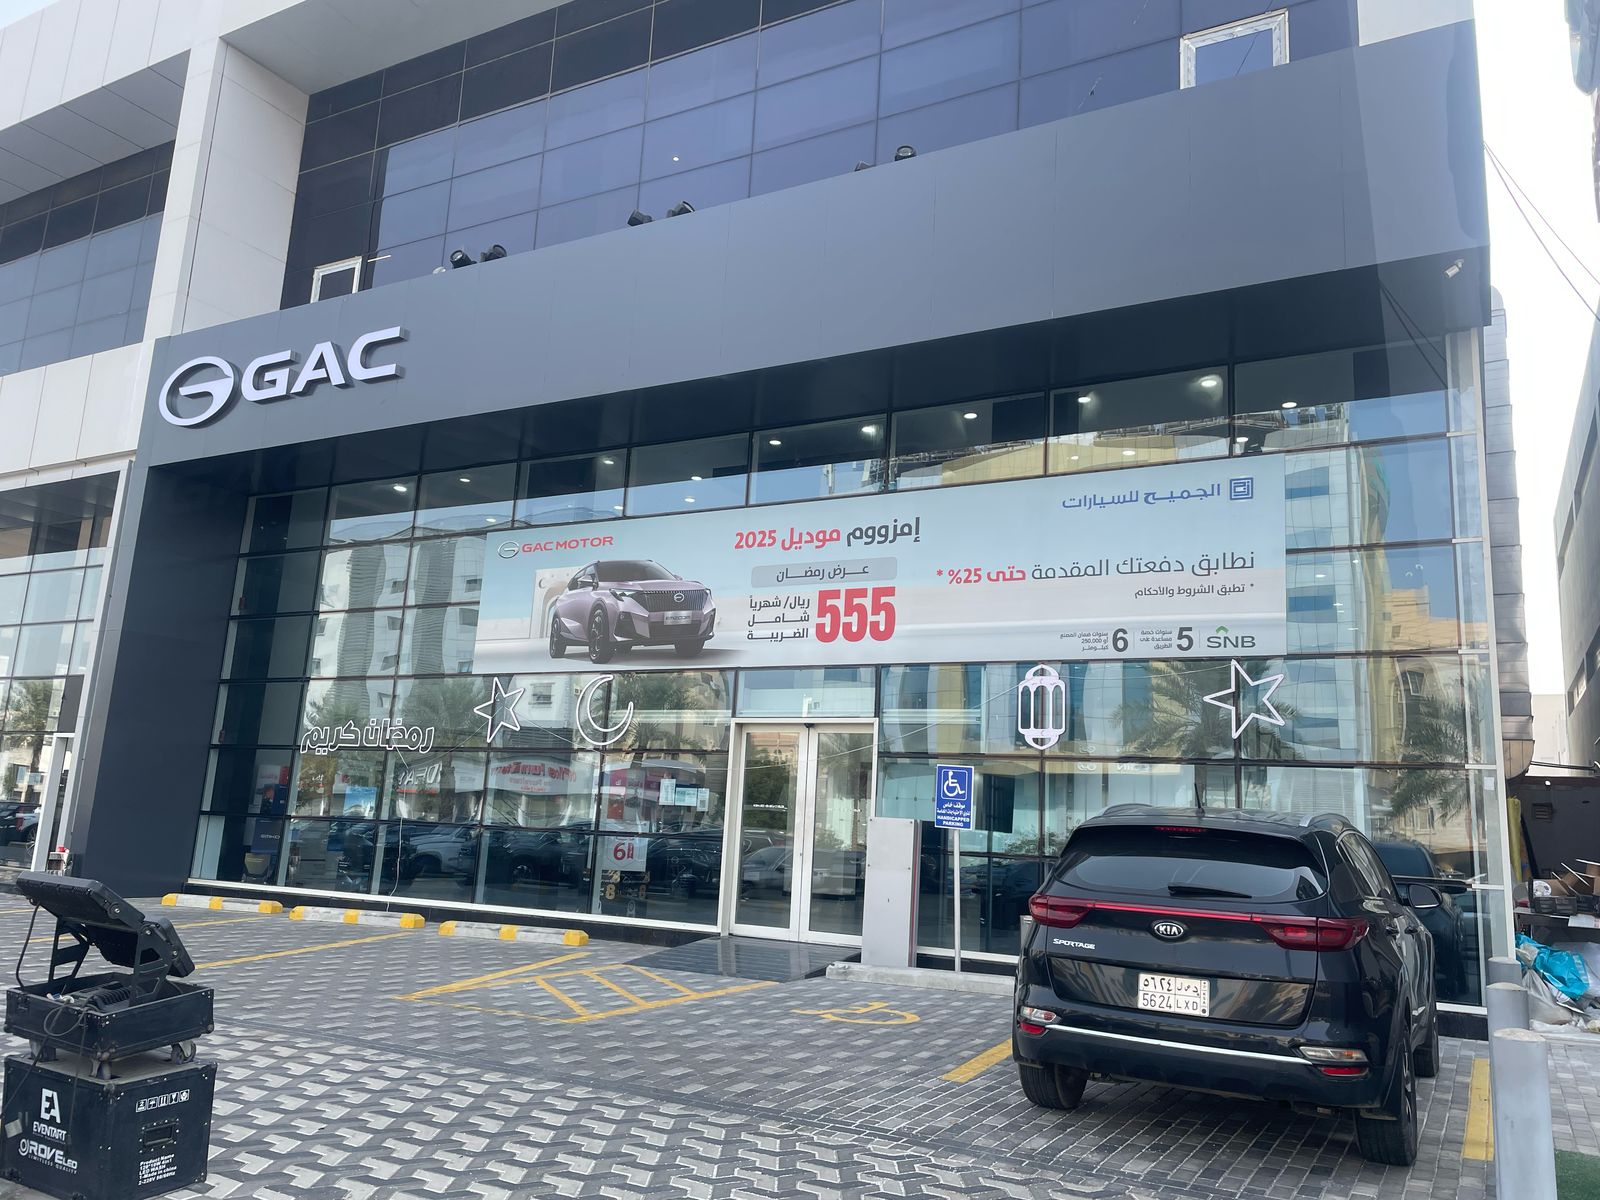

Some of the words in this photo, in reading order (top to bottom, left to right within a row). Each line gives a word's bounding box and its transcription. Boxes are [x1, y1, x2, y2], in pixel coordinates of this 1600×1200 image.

[241, 326, 406, 404] GAC
[1062, 489, 1139, 511] للسيارات
[1144, 483, 1220, 505] الجميح
[734, 529, 777, 550] 2025
[781, 527, 840, 551] موديل
[846, 516, 920, 547] إمزووم
[521, 541, 553, 553] GAC
[555, 535, 614, 551] MOTOR
[776, 565, 825, 583] رمضان
[828, 564, 869, 581] عرض
[986, 564, 1026, 583] حتى
[1031, 558, 1109, 580] المقدمة
[1116, 555, 1185, 576] دفعتك
[1191, 551, 1255, 577] نطابق
[1134, 585, 1175, 599] والأحكام
[1177, 584, 1214, 598] الشروط
[1216, 583, 1245, 598] تطبق
[748, 610, 810, 627] شامل
[815, 586, 896, 643] 555
[747, 627, 809, 643] الضريبة
[1112, 628, 1128, 652] 6
[1176, 626, 1194, 651] 5
[1206, 635, 1256, 649] SNB
[300, 720, 361, 755] كريم
[363, 718, 435, 754] رمضان
[1158, 924, 1179, 936] KIA
[1052, 938, 1096, 950] SPORTAGE
[1142, 992, 1173, 1010] 5624
[32, 1121, 67, 1141] EVENTART
